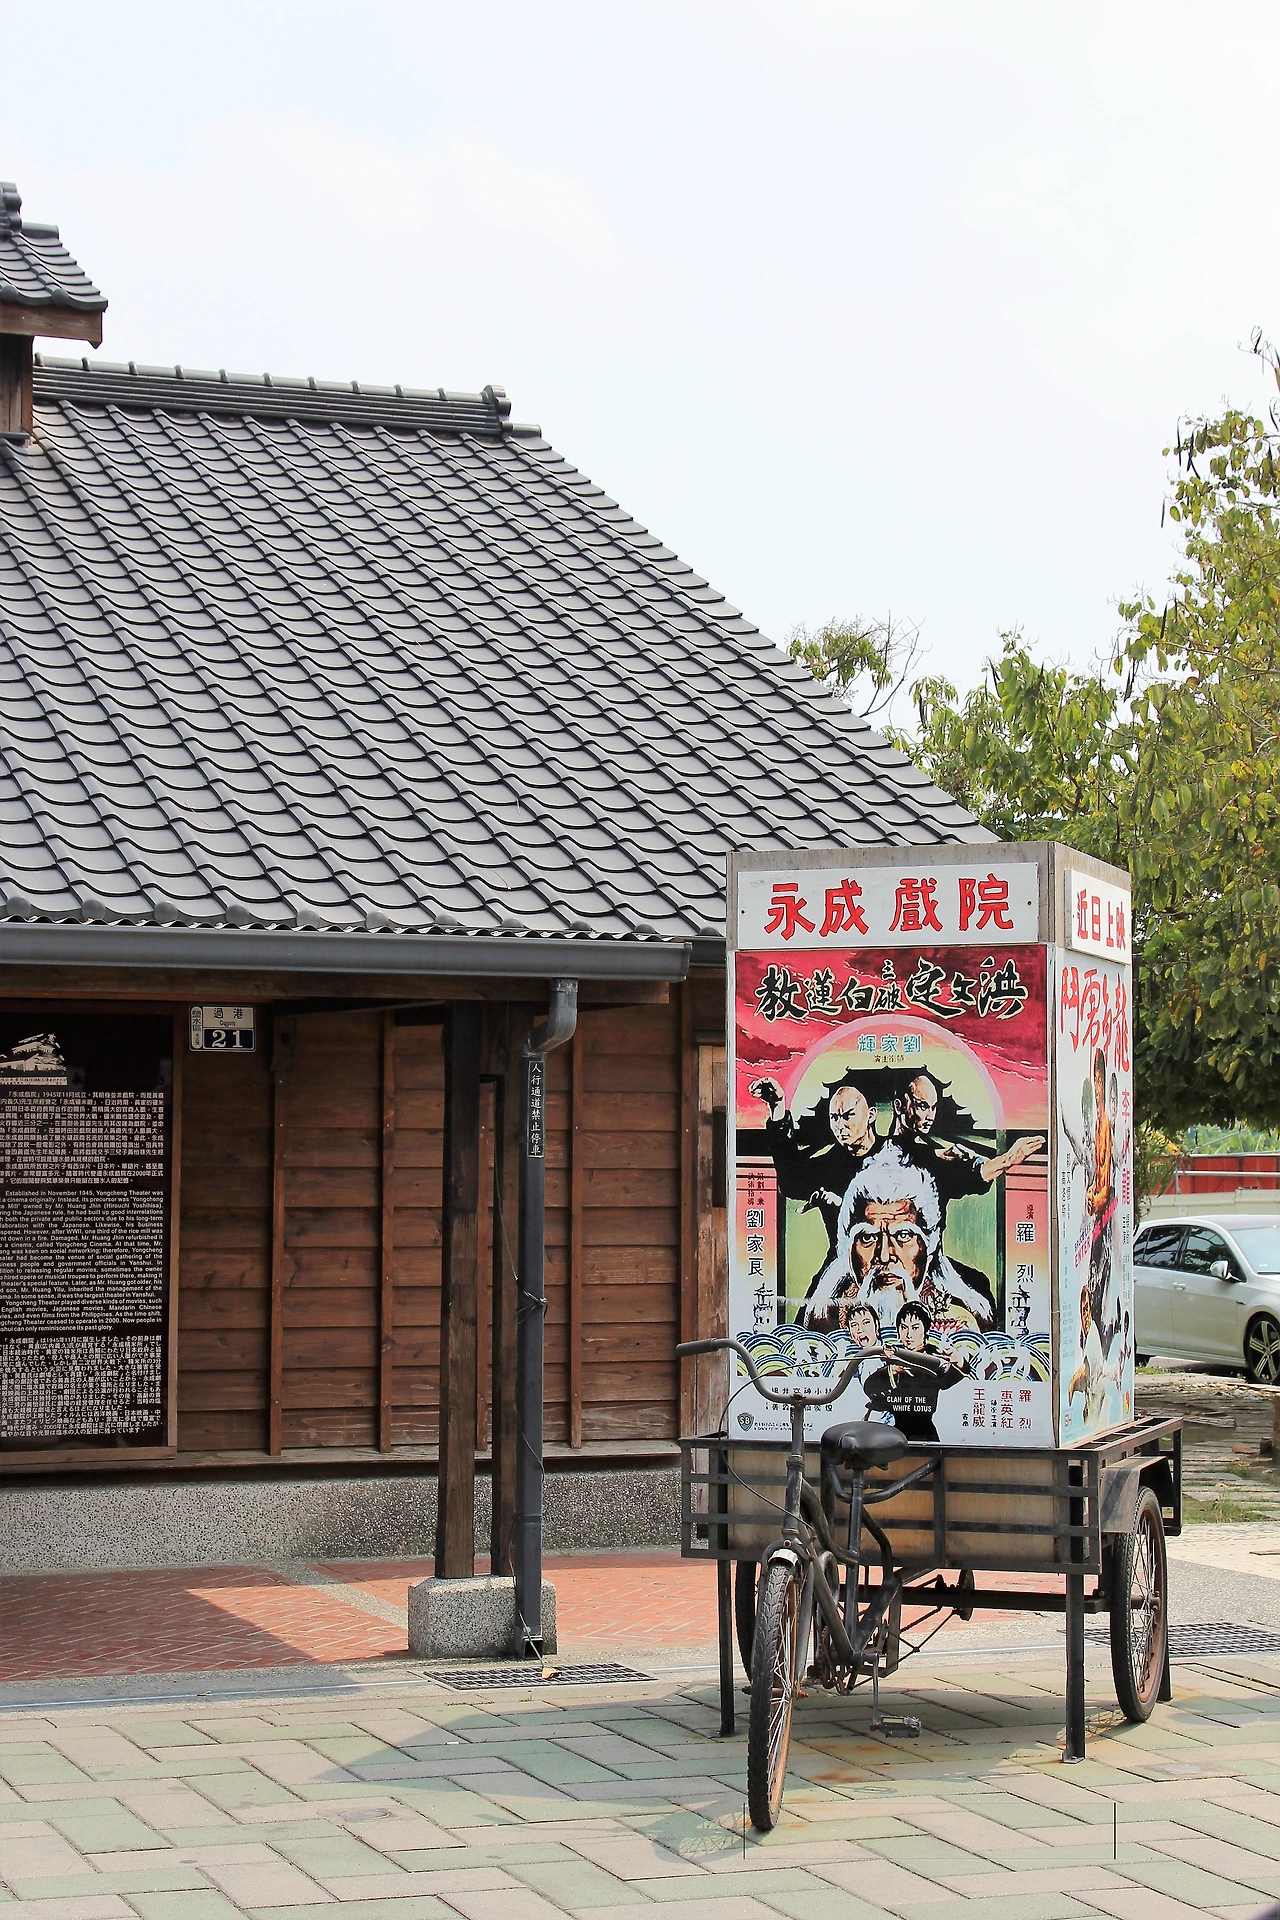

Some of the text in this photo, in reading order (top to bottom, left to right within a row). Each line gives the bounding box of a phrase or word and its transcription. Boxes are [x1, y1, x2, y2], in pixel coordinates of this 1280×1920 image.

[764, 874, 1014, 941] 永成戲院
[1076, 889, 1126, 951] 近日上映
[212, 1030, 243, 1048] 21
[530, 1063, 542, 1156] 人行通道禁止停車
[746, 1209, 764, 1276] 劉家良
[1016, 1223, 1034, 1283] 羅烈
[740, 1416, 750, 1424] SB
[886, 1396, 926, 1404] CLAN OF THE
[892, 1404, 911, 1412] WHITE
[973, 1388, 986, 1428] 王龍威
